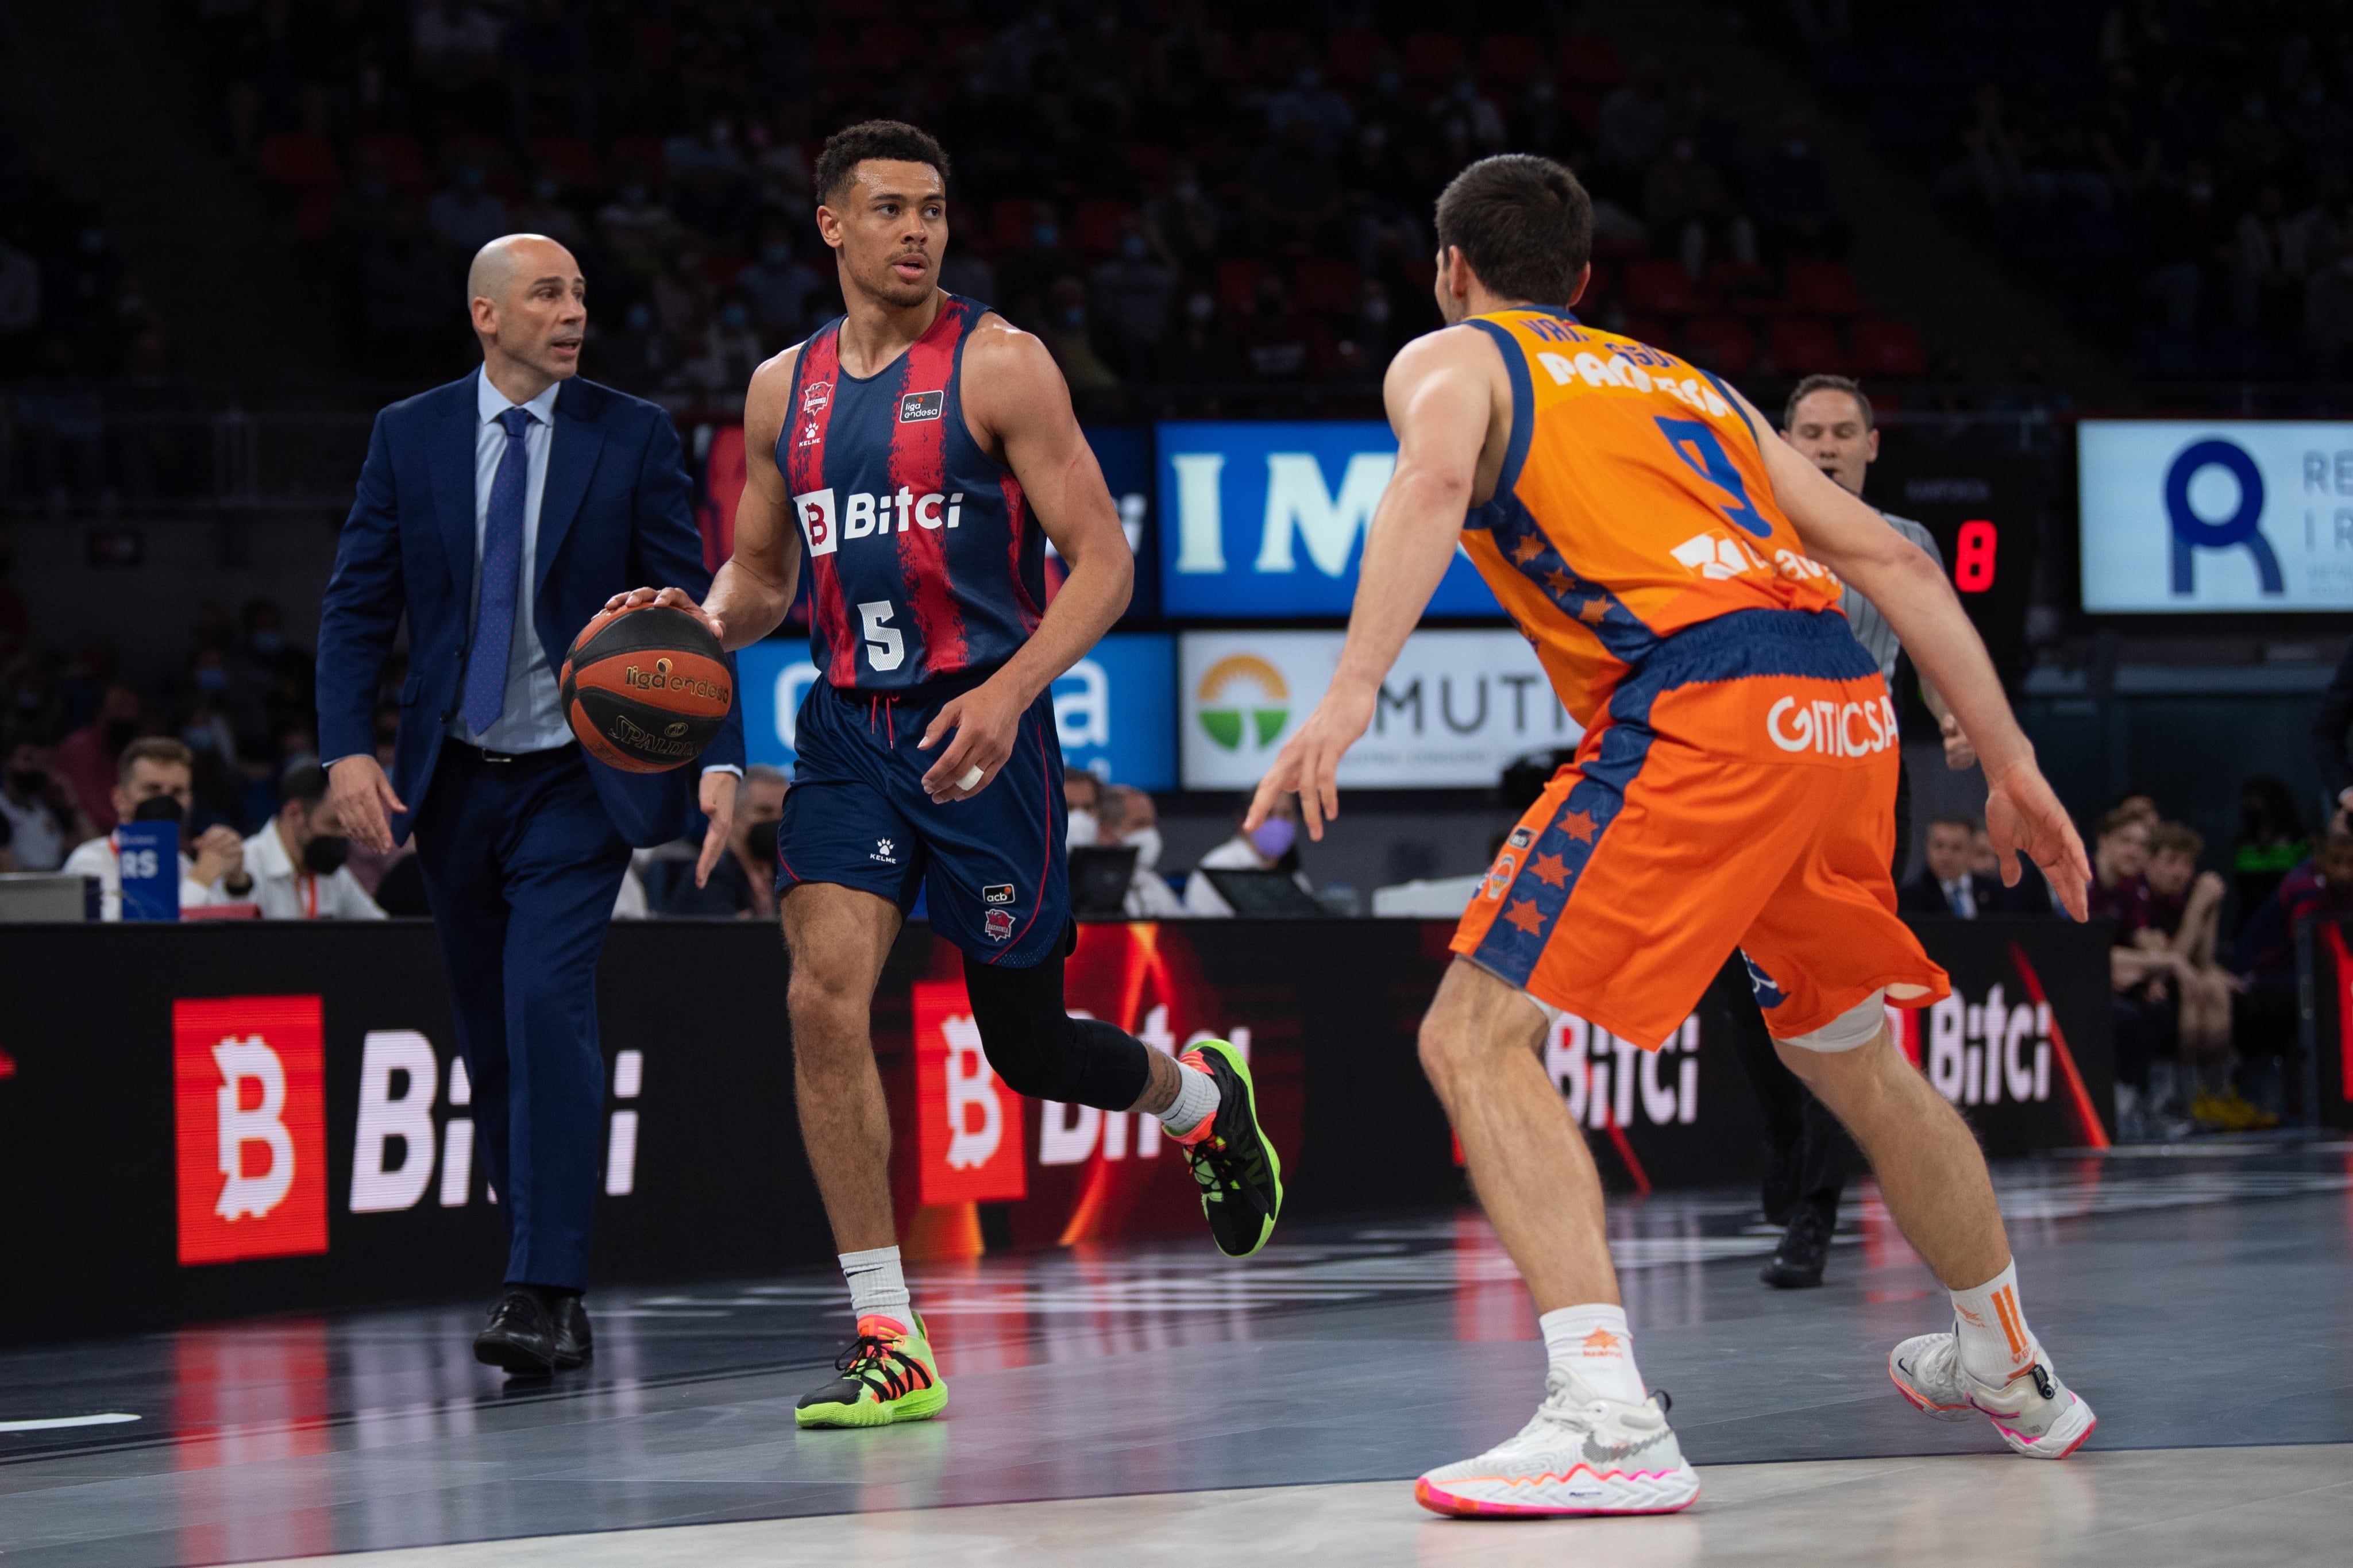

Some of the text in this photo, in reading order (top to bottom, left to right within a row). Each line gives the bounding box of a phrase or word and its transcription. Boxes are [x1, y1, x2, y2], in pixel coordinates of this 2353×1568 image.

[904, 408, 938, 418] endesa
[905, 403, 921, 411] liga
[799, 438, 820, 447] KELME
[1653, 415, 1773, 539] 9
[844, 485, 964, 540] Bitci
[1171, 452, 1402, 578] IM
[1955, 520, 1997, 593] 8
[858, 600, 904, 671] 5
[626, 666, 728, 704] liga endesa
[870, 853, 896, 864] KELME
[986, 892, 1008, 902] acb
[1928, 982, 2051, 1106] Bitci
[349, 1029, 643, 1213] Bii
